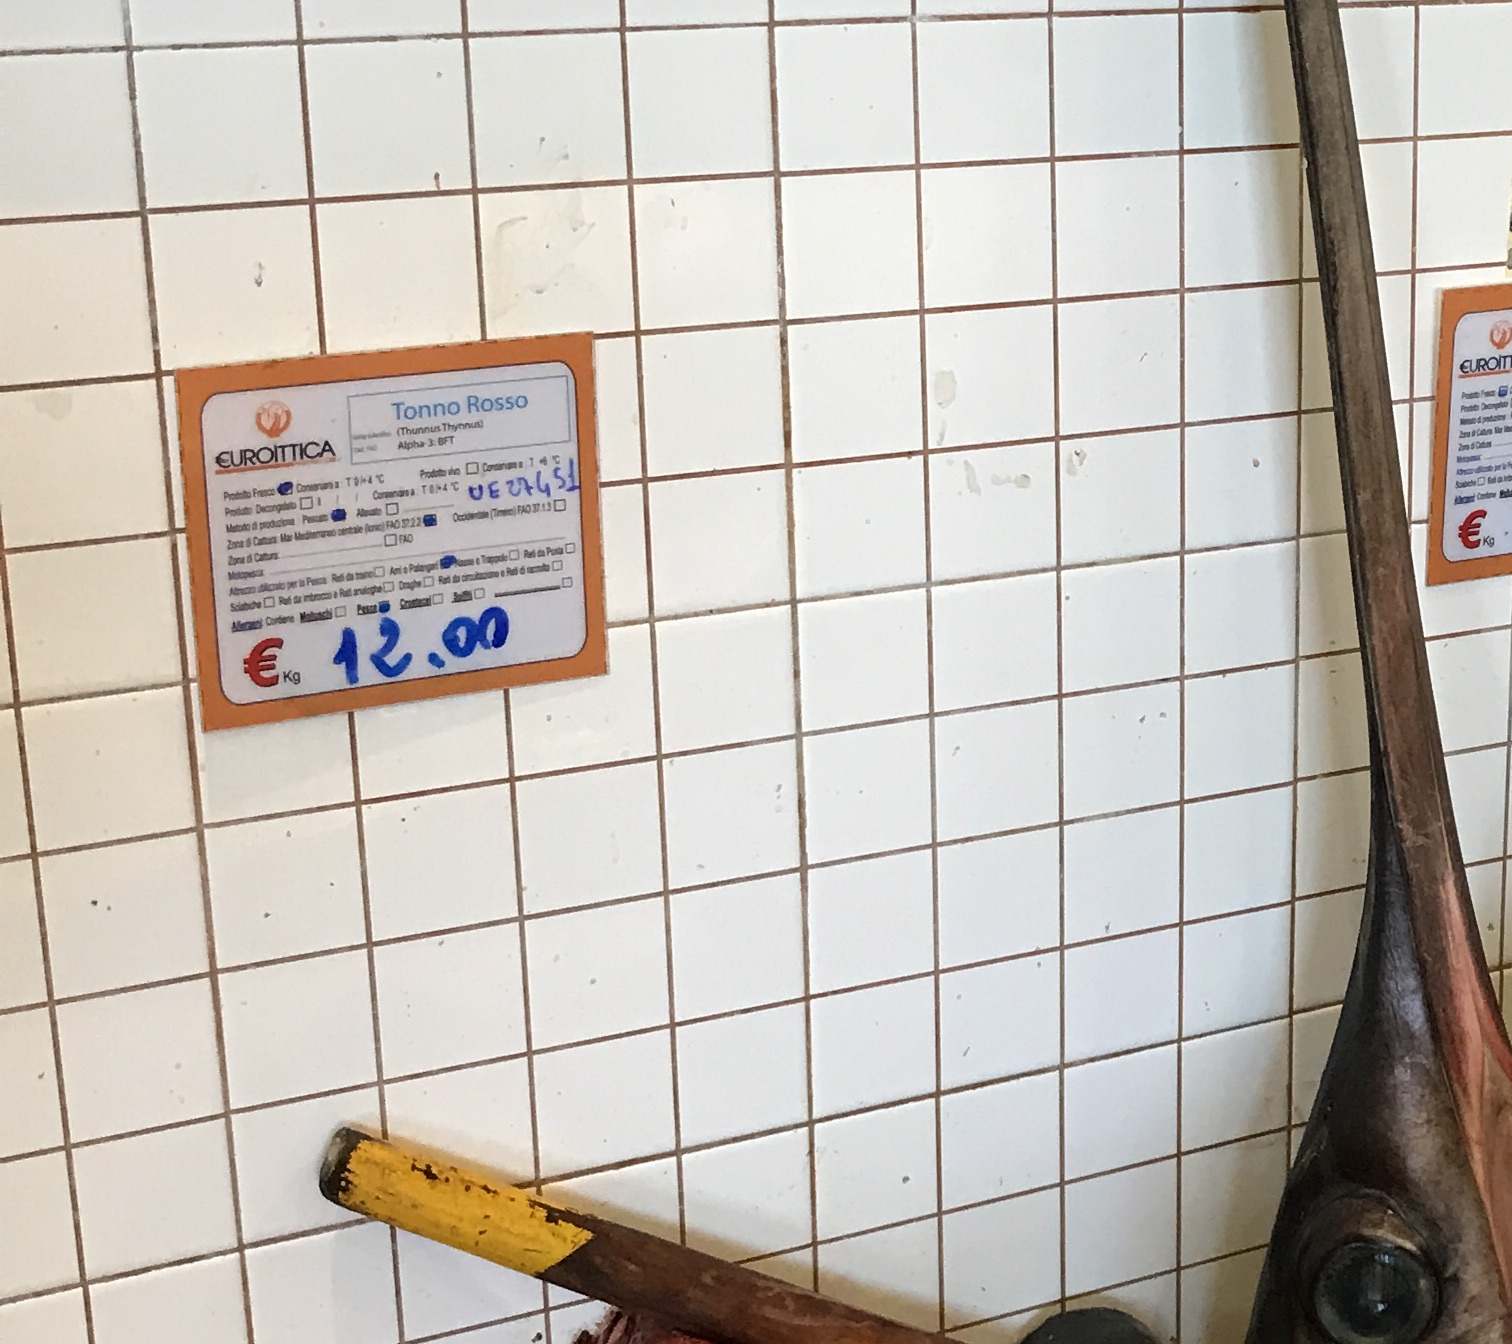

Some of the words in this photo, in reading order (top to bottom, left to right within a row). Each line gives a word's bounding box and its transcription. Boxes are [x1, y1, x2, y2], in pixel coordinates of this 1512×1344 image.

[391, 400, 461, 420] Tonno
[467, 394, 528, 414] Rosso
[396, 424, 441, 437] (Thunnus
[442, 419, 484, 432] Thynnus)
[438, 436, 455, 446] BFT
[253, 487, 275, 497] Fresco
[1458, 509, 1487, 549] €
[1482, 535, 1495, 547] Kg
[400, 534, 413, 543] FAO
[243, 637, 284, 688] €
[283, 670, 300, 684] Kg
